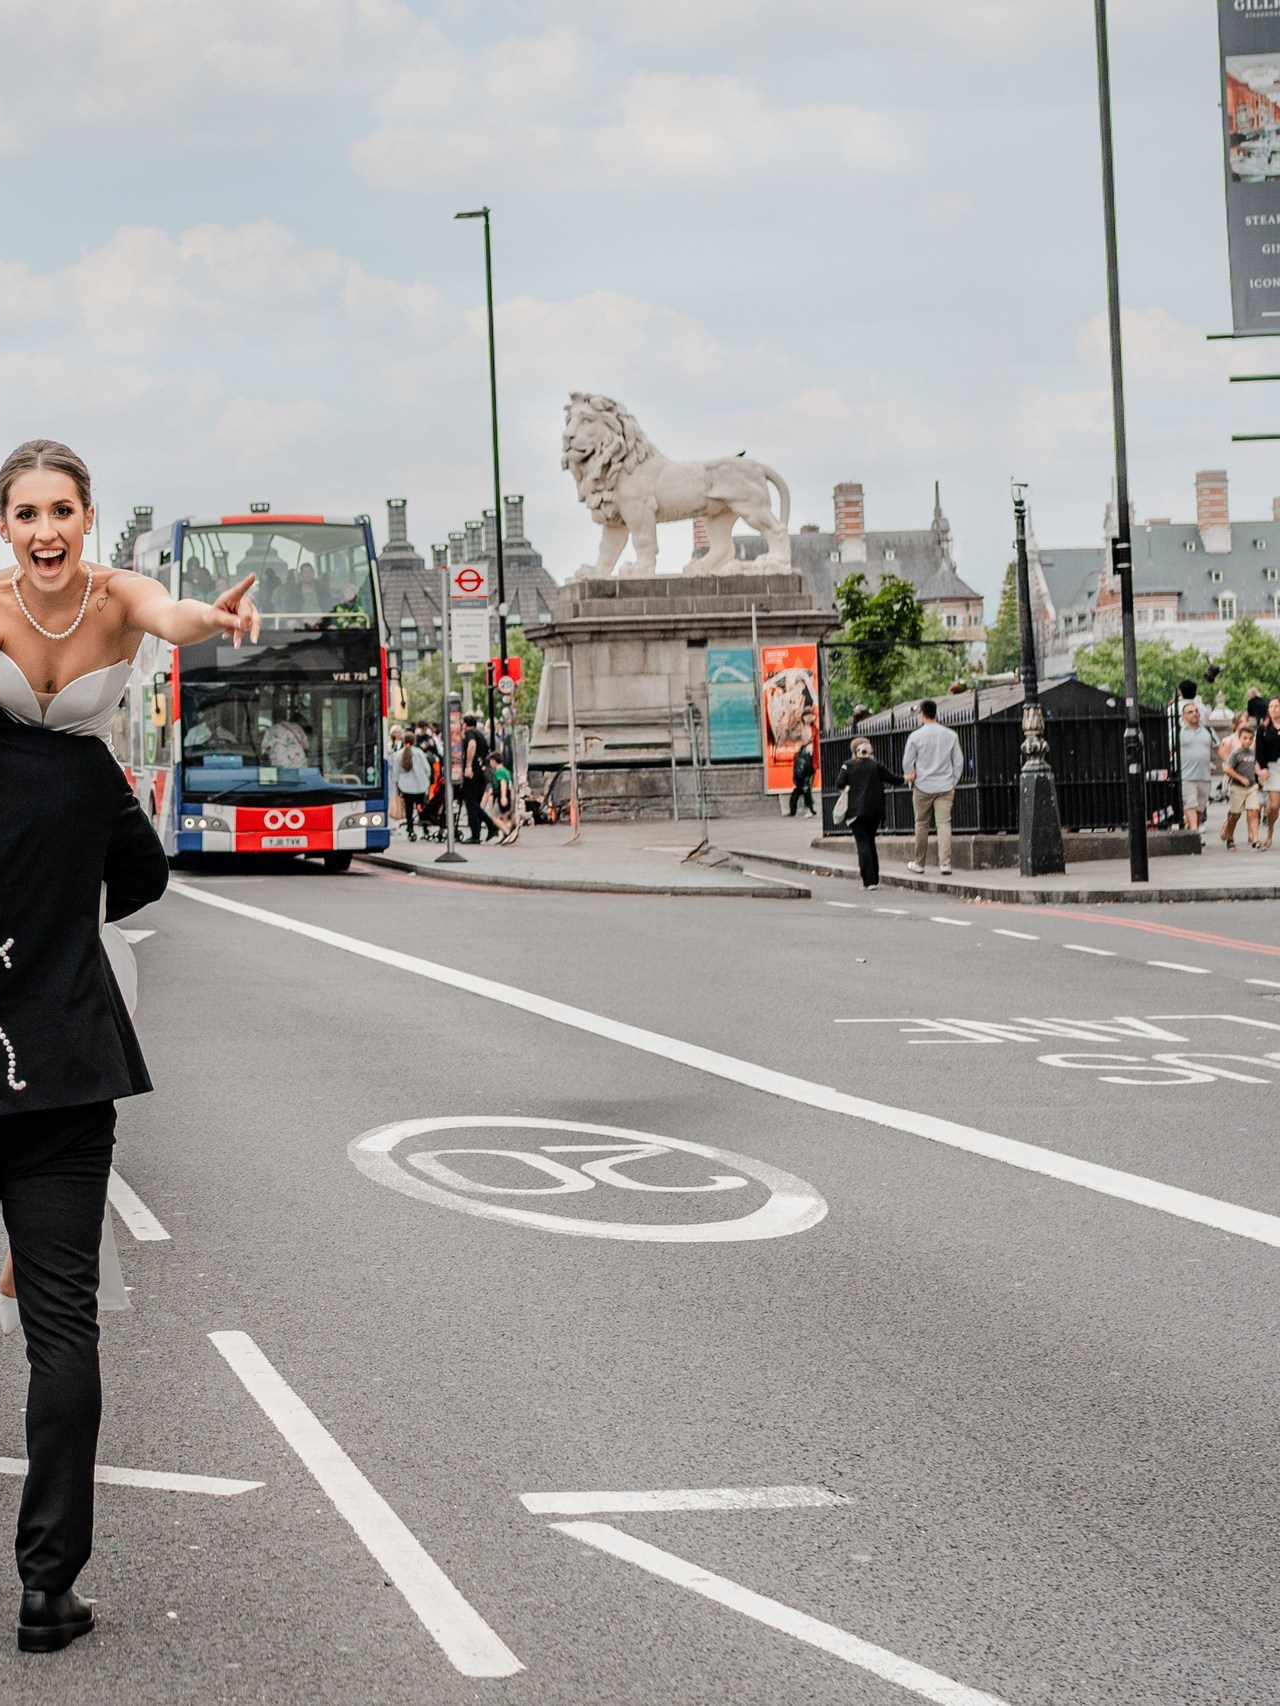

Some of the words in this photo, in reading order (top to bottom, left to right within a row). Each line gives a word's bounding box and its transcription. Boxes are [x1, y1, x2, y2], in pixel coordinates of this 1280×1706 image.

[333, 672, 350, 680] VXE
[1036, 1052, 1280, 1085] US
[407, 1144, 748, 1195] 20
